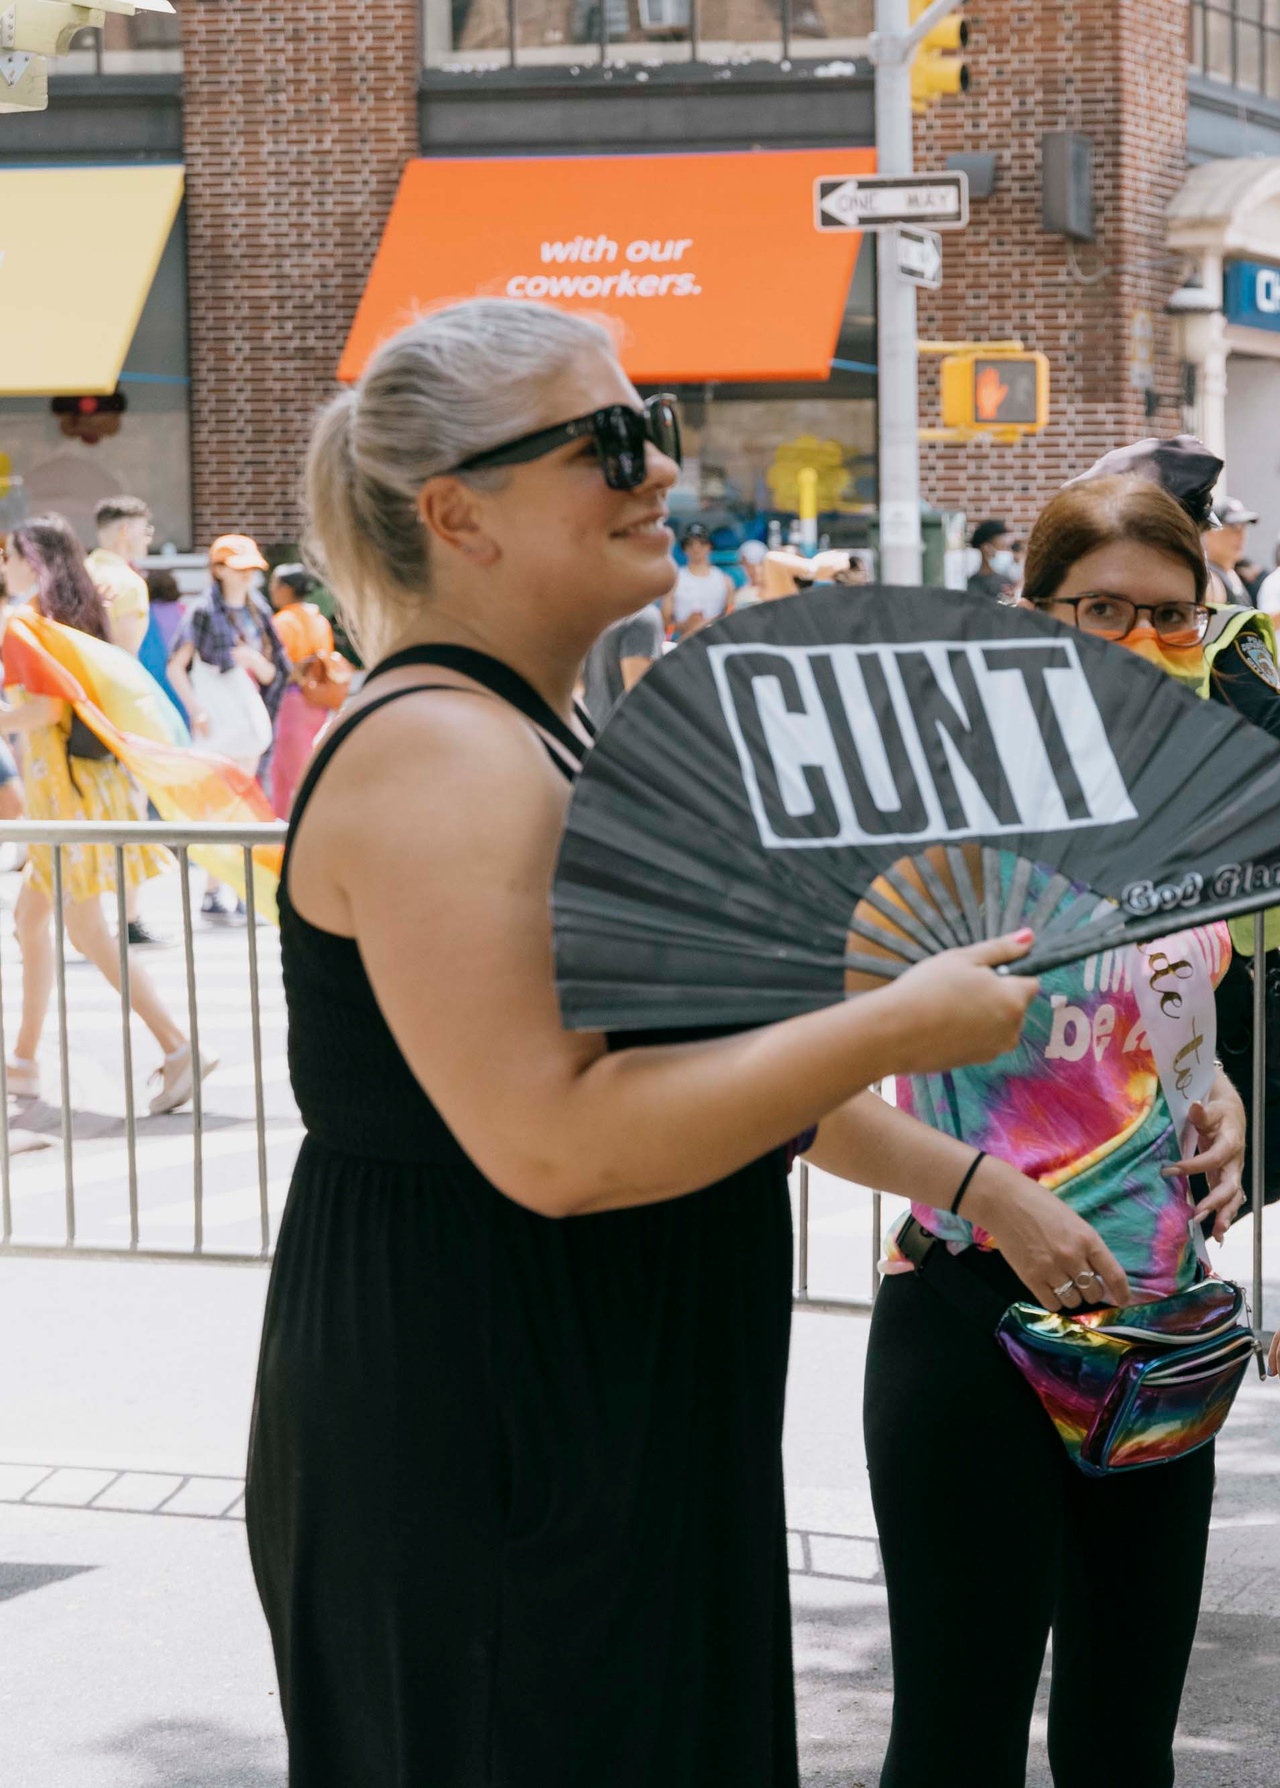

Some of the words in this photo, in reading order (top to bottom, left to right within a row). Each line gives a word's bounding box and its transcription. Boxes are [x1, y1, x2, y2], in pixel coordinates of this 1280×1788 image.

[835, 192, 881, 212] ONE
[540, 235, 618, 263] with
[625, 238, 693, 263] our
[506, 269, 702, 298] coworkers.
[723, 645, 1093, 838] CUNT
[1045, 995, 1116, 1062] be
